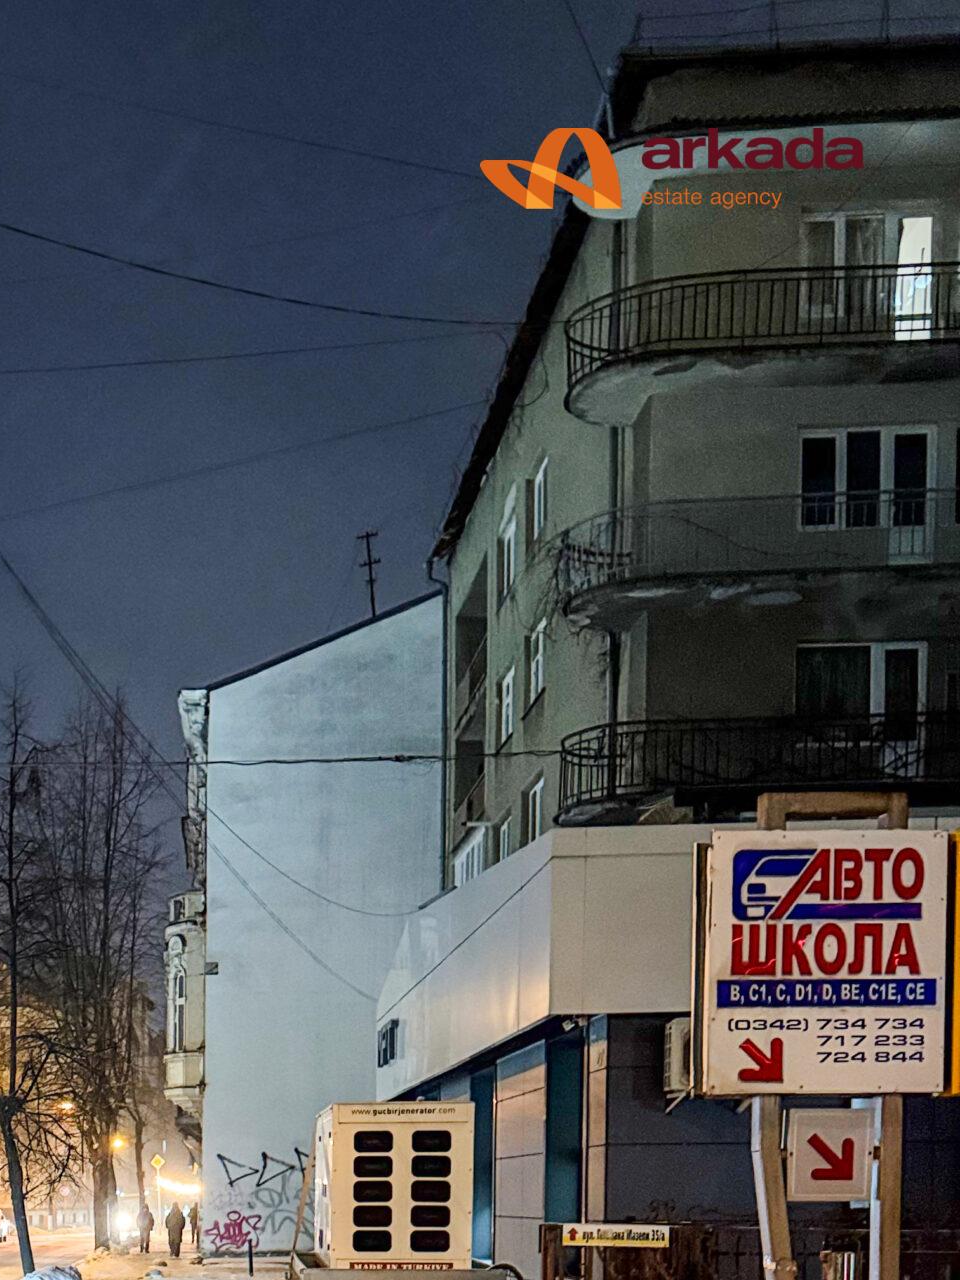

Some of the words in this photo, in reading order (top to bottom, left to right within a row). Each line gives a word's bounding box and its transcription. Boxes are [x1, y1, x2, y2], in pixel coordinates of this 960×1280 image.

[768, 848, 924, 920] АВТО
[730, 923, 921, 976] ШКОЛА
[730, 984, 745, 1004] B,
[749, 984, 772, 1004] C1,
[776, 983, 790, 1004] C,
[795, 983, 818, 1003] D1,
[822, 983, 836, 1003] D,
[840, 983, 864, 1003] BE,
[869, 983, 901, 1003] C1E,
[905, 982, 925, 1000] CE
[728, 1018, 809, 1031] (0342)
[816, 1018, 867, 1030] 734
[874, 1018, 925, 1029] 734
[816, 1035, 867, 1046] 717
[874, 1035, 925, 1046] 233
[816, 1051, 867, 1063] 724
[874, 1051, 925, 1063] 844
